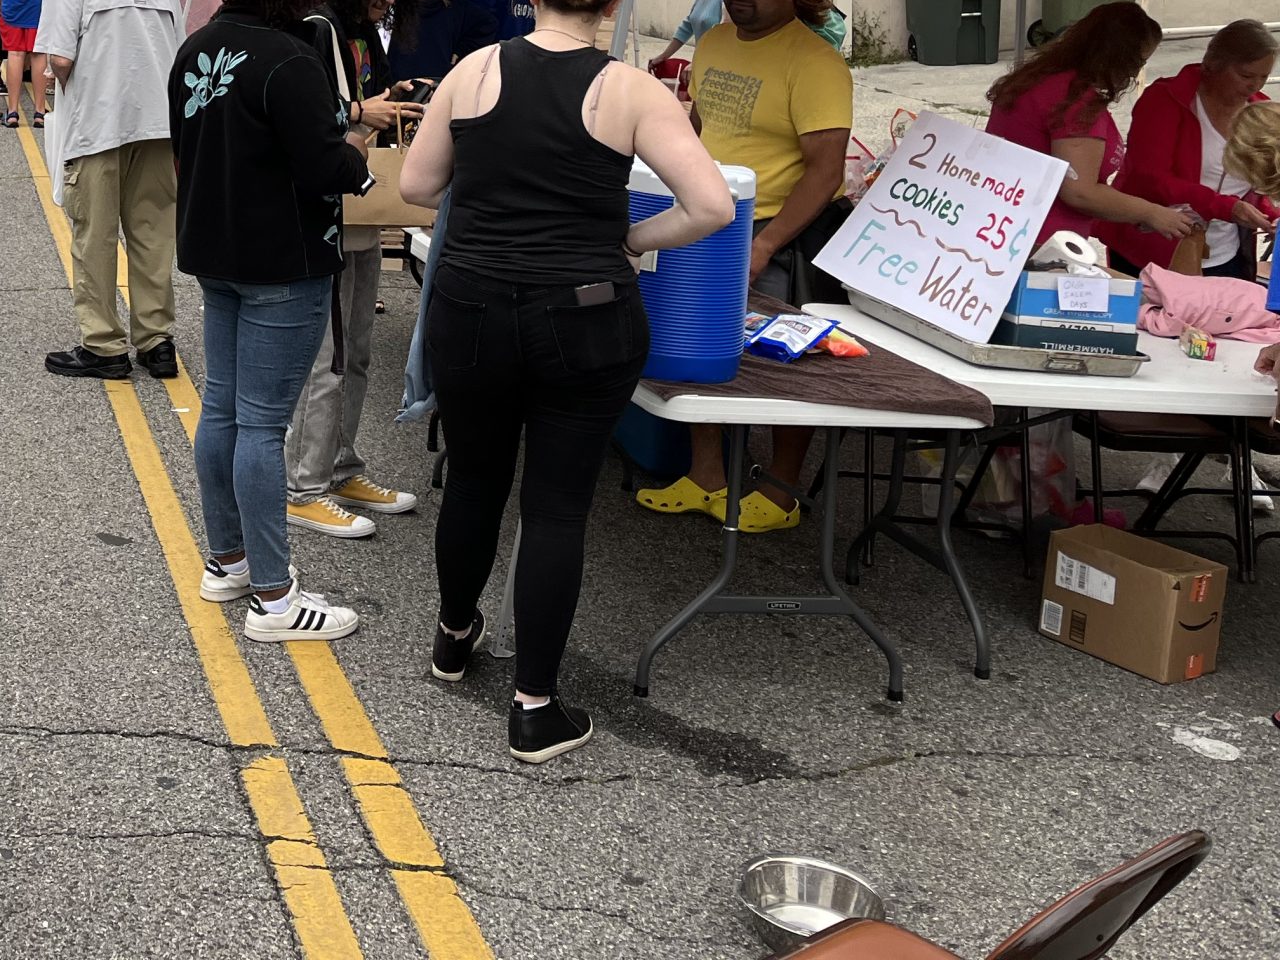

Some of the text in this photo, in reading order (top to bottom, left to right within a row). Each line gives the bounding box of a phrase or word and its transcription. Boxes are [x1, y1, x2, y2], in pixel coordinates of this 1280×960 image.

[908, 133, 937, 170] 2
[843, 219, 993, 326] Free Water
[1070, 300, 1089, 309] DAYS
[1042, 342, 1114, 354] HAMMERMILL
